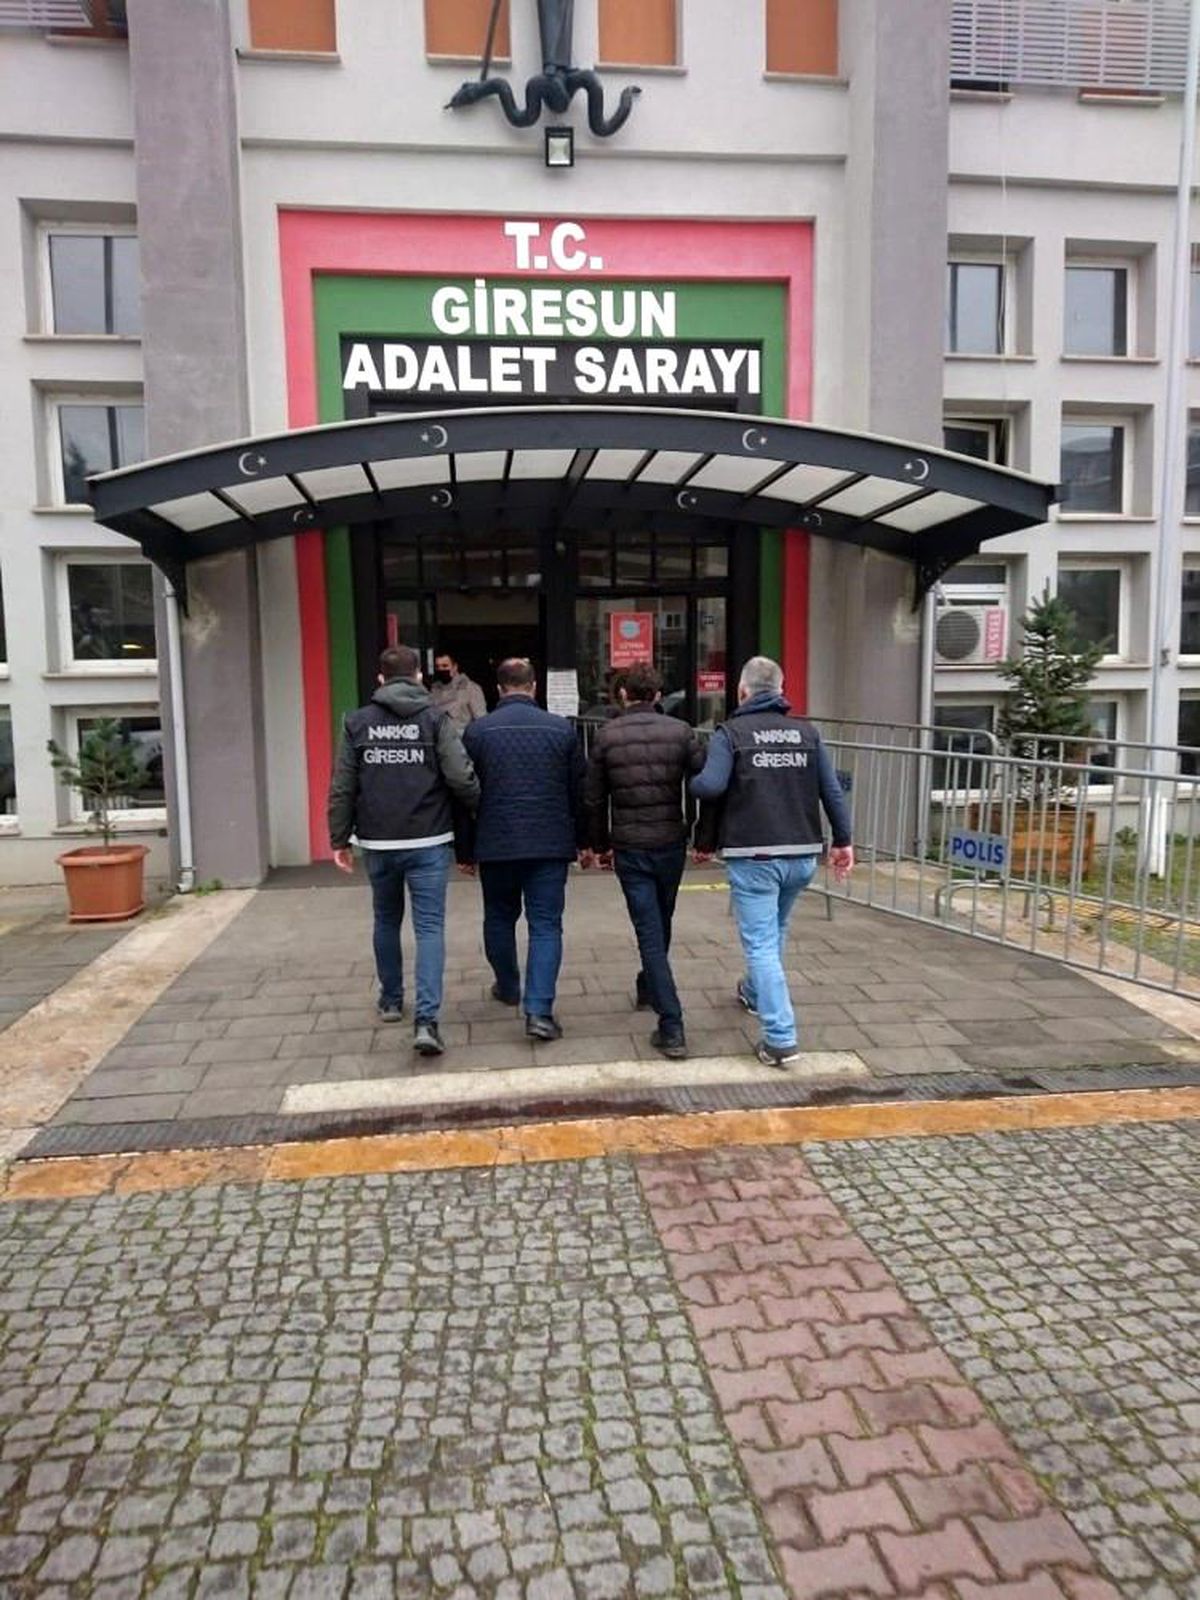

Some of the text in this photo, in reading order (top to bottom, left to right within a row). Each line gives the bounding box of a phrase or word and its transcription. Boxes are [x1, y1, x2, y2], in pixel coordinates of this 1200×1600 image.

[504, 221, 604, 271] T.C.
[431, 278, 677, 338] GİRESUN
[342, 343, 761, 395] ADALET SARAYI
[363, 746, 424, 764] GİRESUN
[752, 751, 808, 768] GİRESUN
[951, 836, 1004, 865] POLİS
